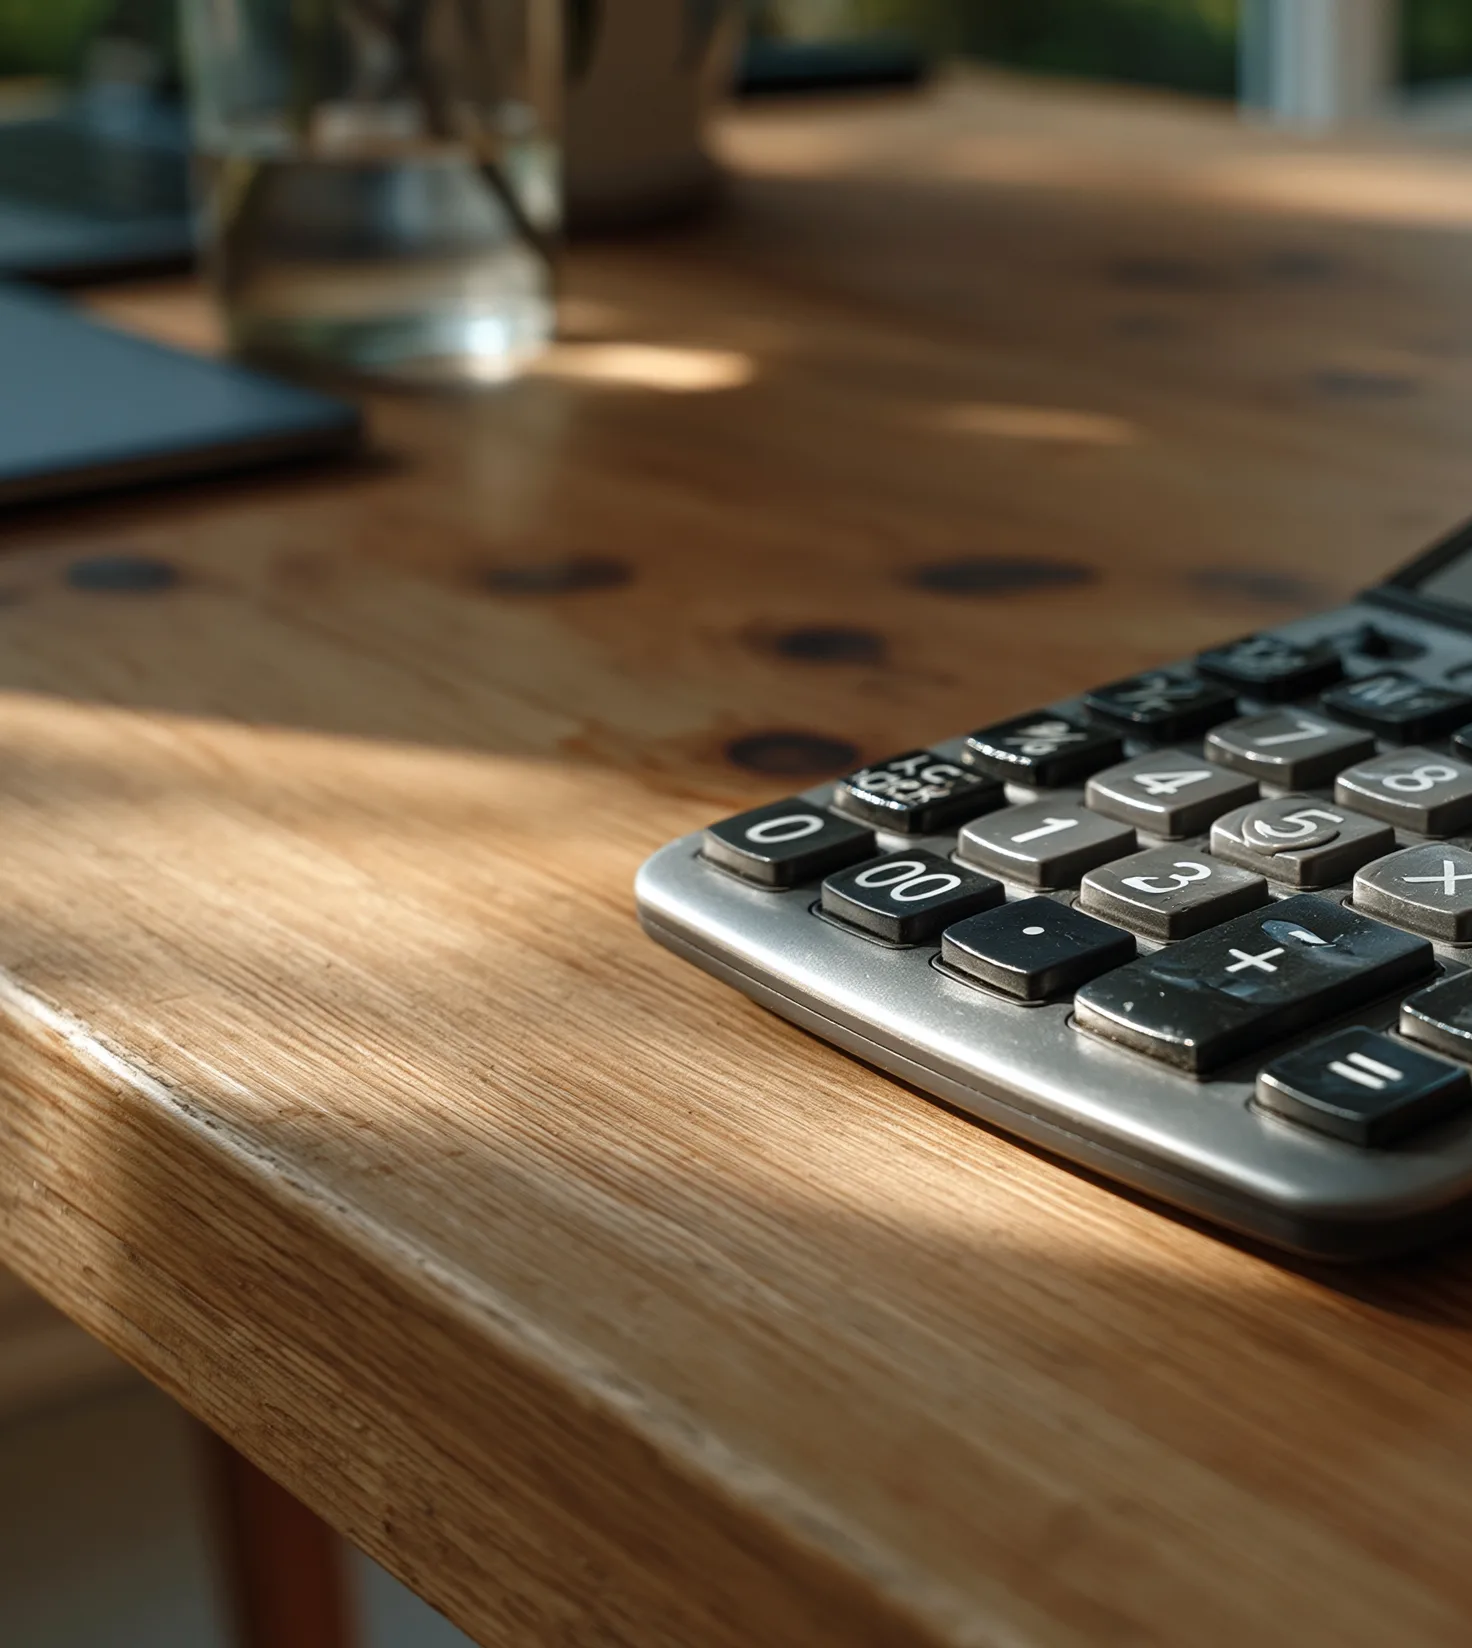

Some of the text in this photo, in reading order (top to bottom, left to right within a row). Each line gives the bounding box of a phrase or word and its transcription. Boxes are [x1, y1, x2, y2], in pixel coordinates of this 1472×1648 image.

[1252, 720, 1329, 747] 7
[1133, 769, 1212, 795] 4
[1381, 763, 1459, 793] 8
[744, 813, 825, 844] 0
[1011, 817, 1079, 844] 1
[1254, 808, 1345, 840] 5
[854, 860, 962, 902] 00
[1121, 861, 1212, 895] 3
[1225, 946, 1286, 974] +
[1327, 1051, 1404, 1090] =
